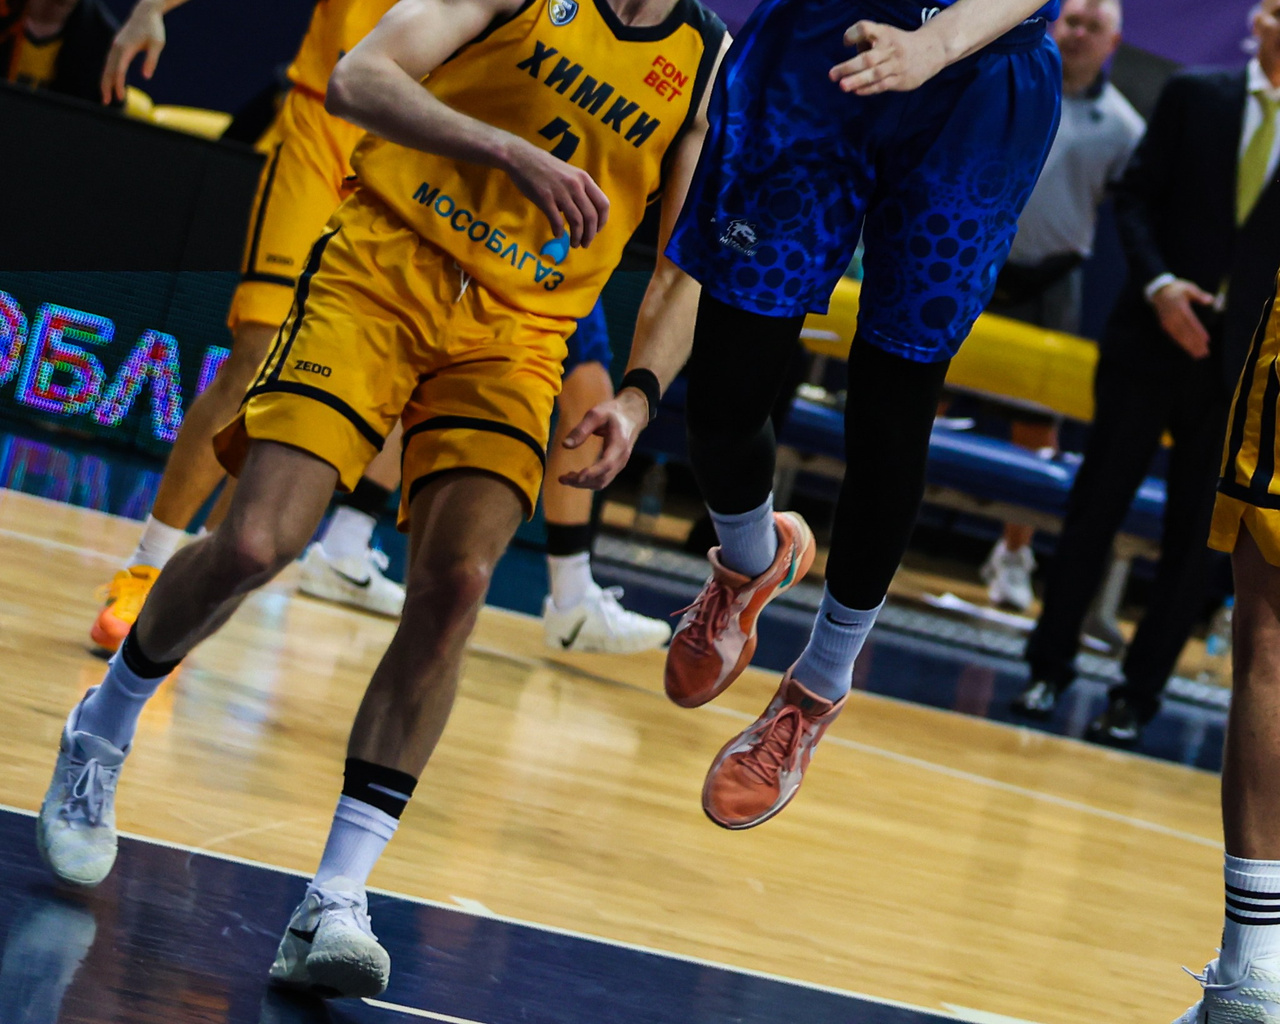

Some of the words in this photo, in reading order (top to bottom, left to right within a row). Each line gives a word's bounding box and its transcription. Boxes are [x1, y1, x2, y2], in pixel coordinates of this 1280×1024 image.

[643, 69, 682, 102] BET
[652, 54, 689, 88] FON
[516, 40, 661, 148] ХИМКИ
[412, 182, 565, 291] МОСОБЛГАЗ
[294, 360, 332, 377] ZEDO
